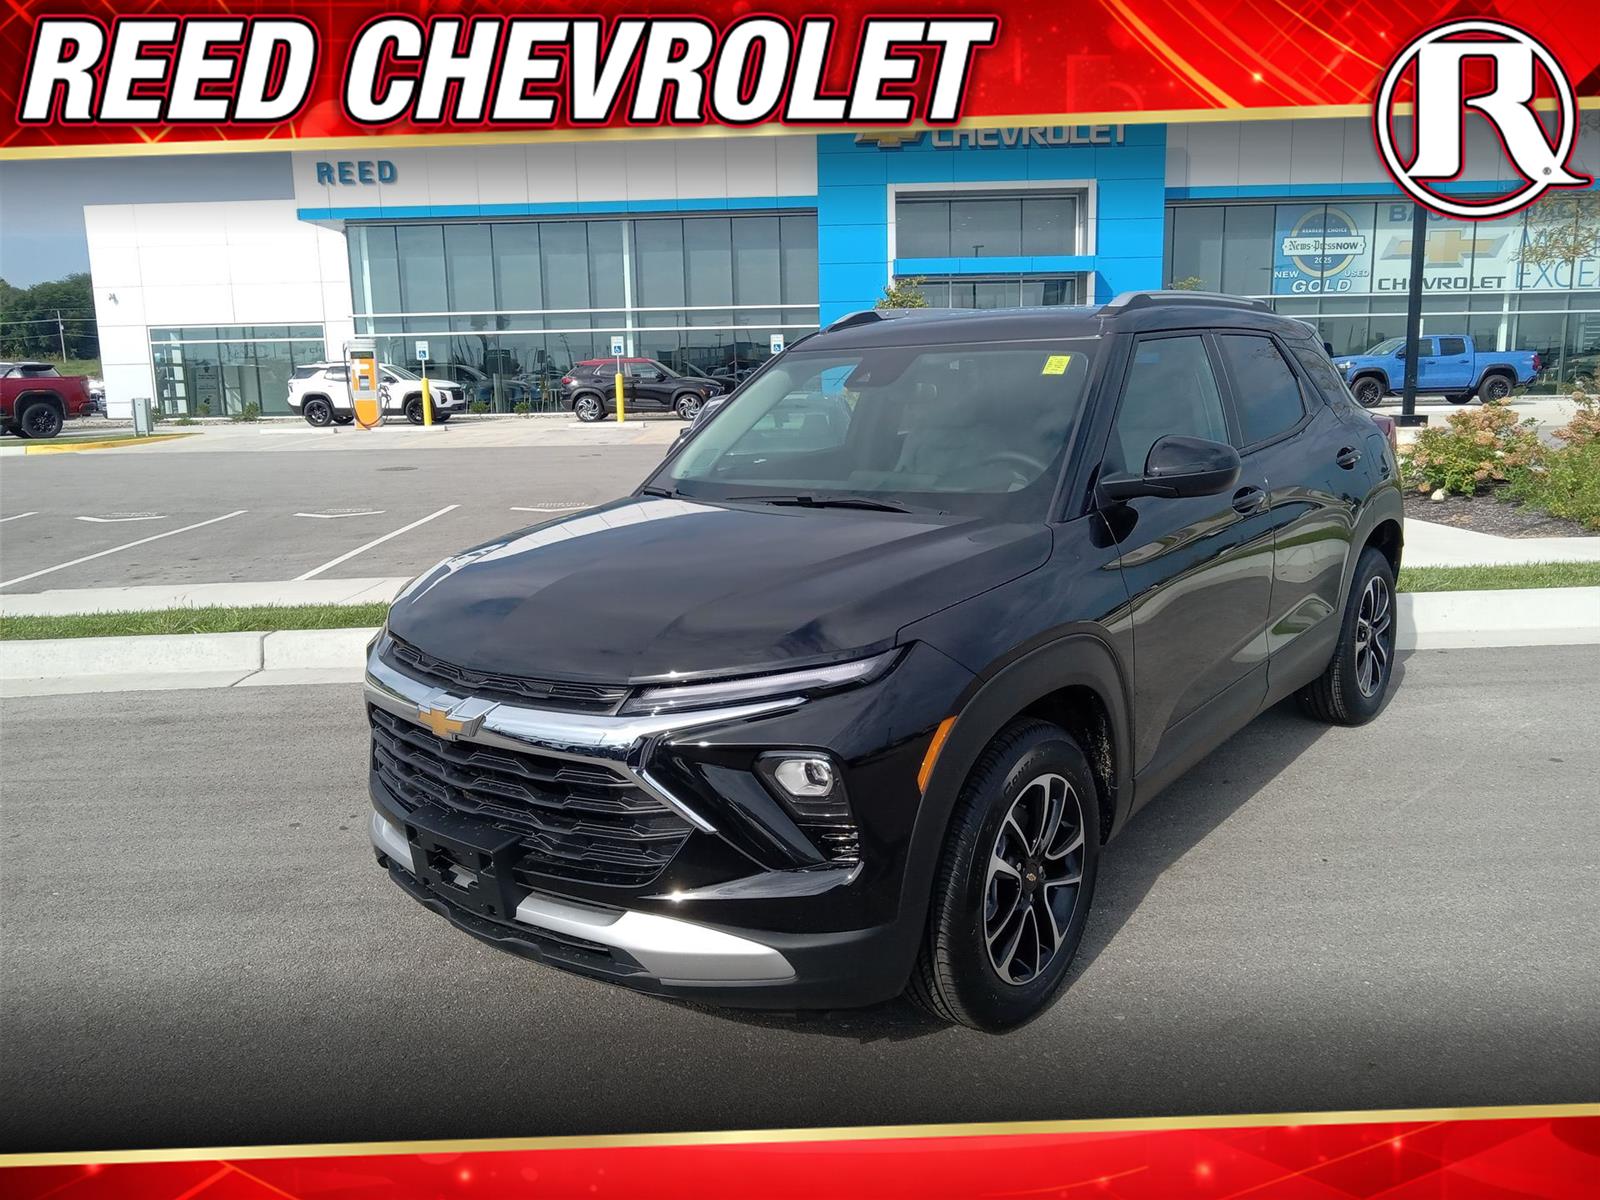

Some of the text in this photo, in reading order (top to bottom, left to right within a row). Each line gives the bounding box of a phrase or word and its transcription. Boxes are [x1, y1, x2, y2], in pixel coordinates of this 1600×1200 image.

[931, 124, 1127, 147] CHEVROLET
[316, 160, 398, 186] REED
[1314, 255, 1333, 265] 2025
[1275, 270, 1299, 279] NEW
[1344, 269, 1370, 278] USED
[1515, 259, 1600, 289] EXCE
[1291, 279, 1353, 294] GOLD
[1378, 275, 1507, 291] CHVROLET
